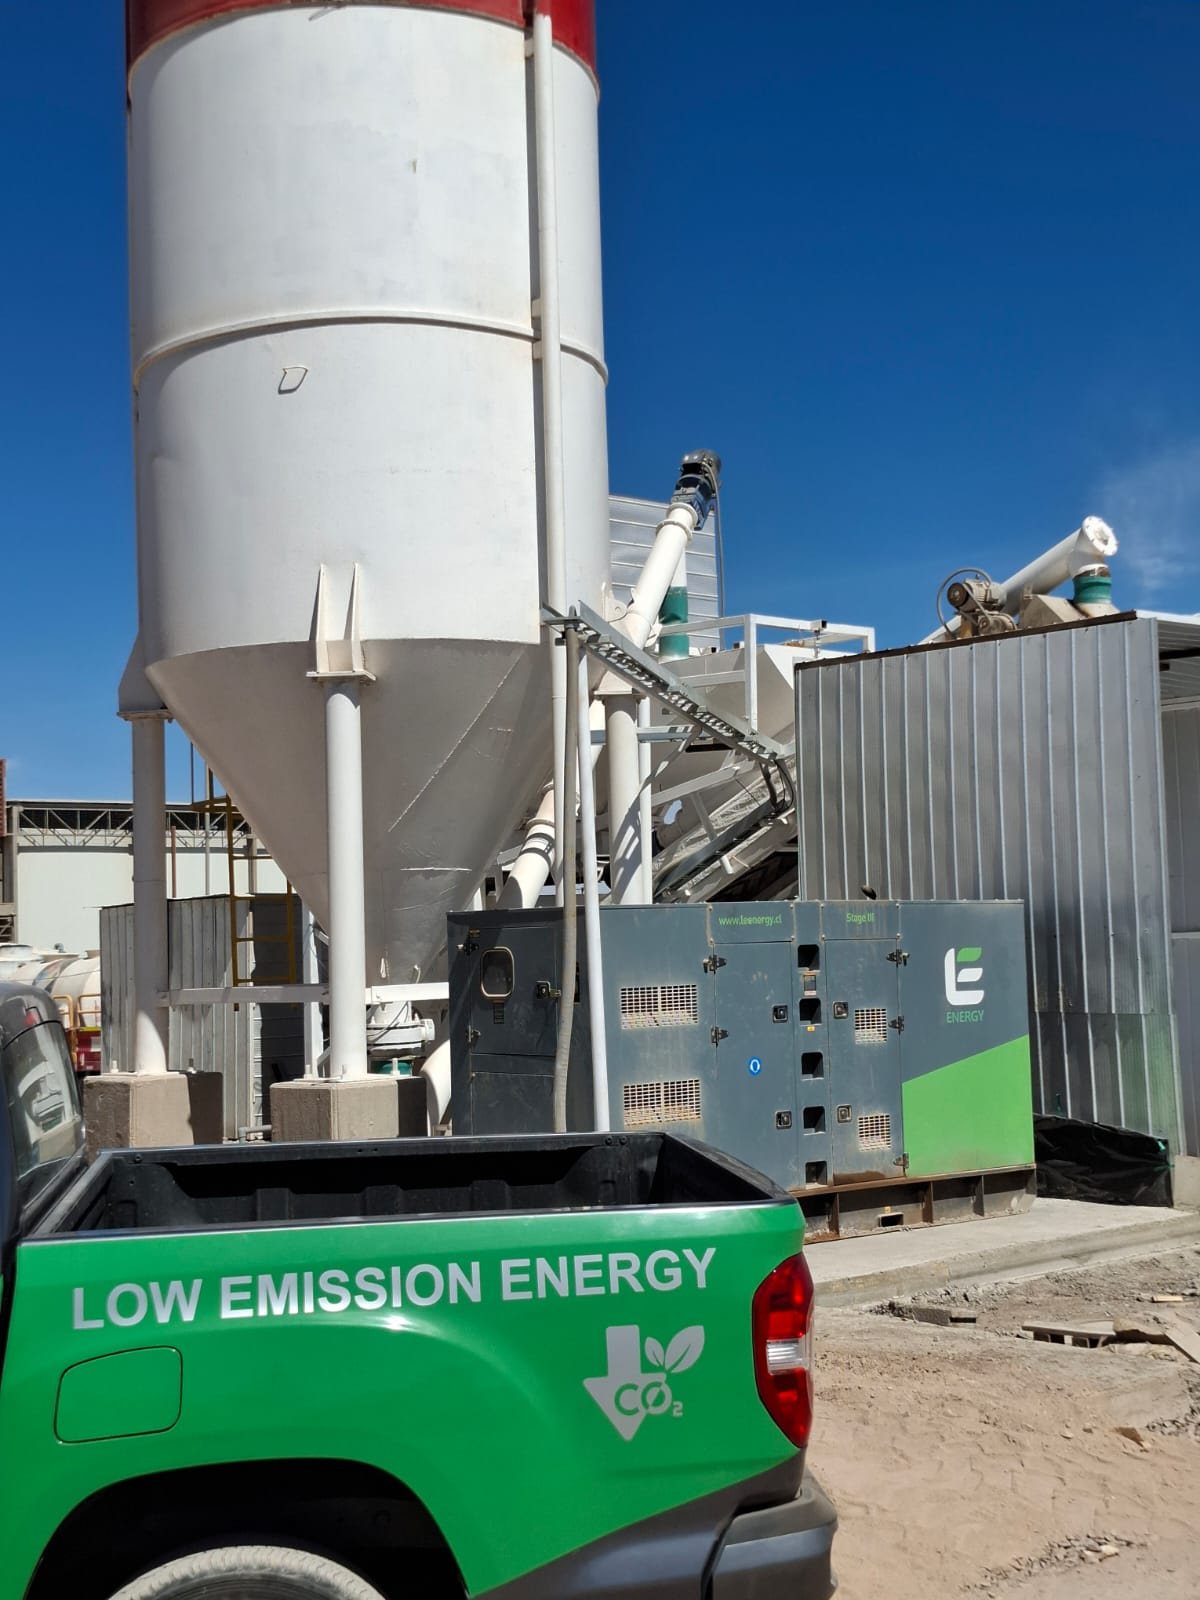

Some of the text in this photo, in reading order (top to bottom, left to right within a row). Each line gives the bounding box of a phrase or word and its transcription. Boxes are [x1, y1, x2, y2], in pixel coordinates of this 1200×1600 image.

[846, 912, 867, 925] Stage
[946, 1009, 984, 1024] ENERGY
[73, 1247, 717, 1330] LOW EMISSION ENERGY
